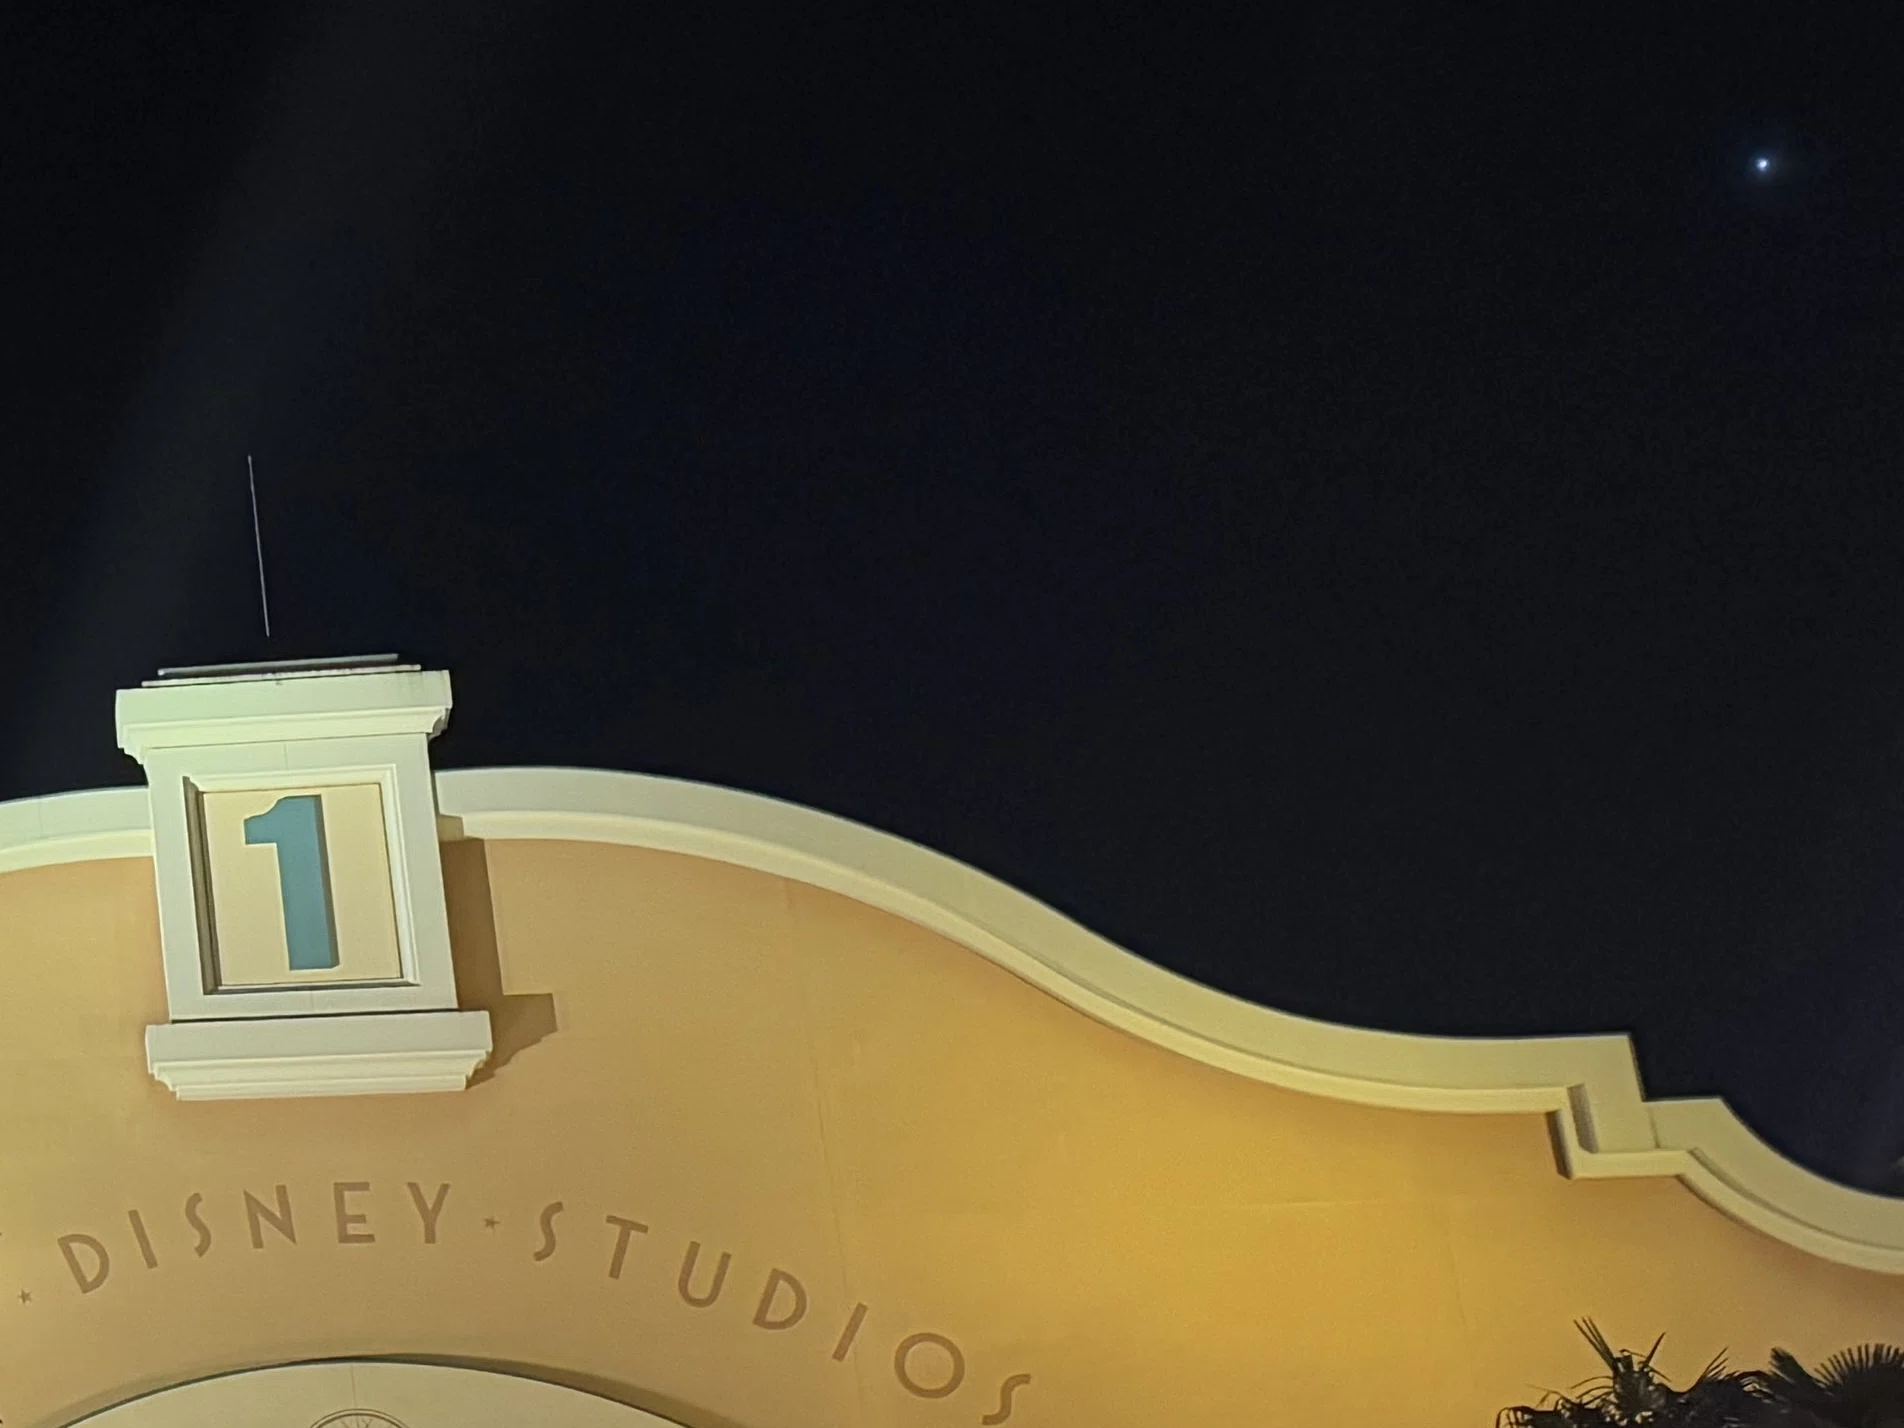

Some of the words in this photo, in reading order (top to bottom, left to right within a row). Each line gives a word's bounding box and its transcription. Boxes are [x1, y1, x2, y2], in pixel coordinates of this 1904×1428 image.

[243, 794, 340, 971] 1
[57, 1181, 452, 1294] DISNEY
[532, 1201, 1032, 1427] STUDIOS
